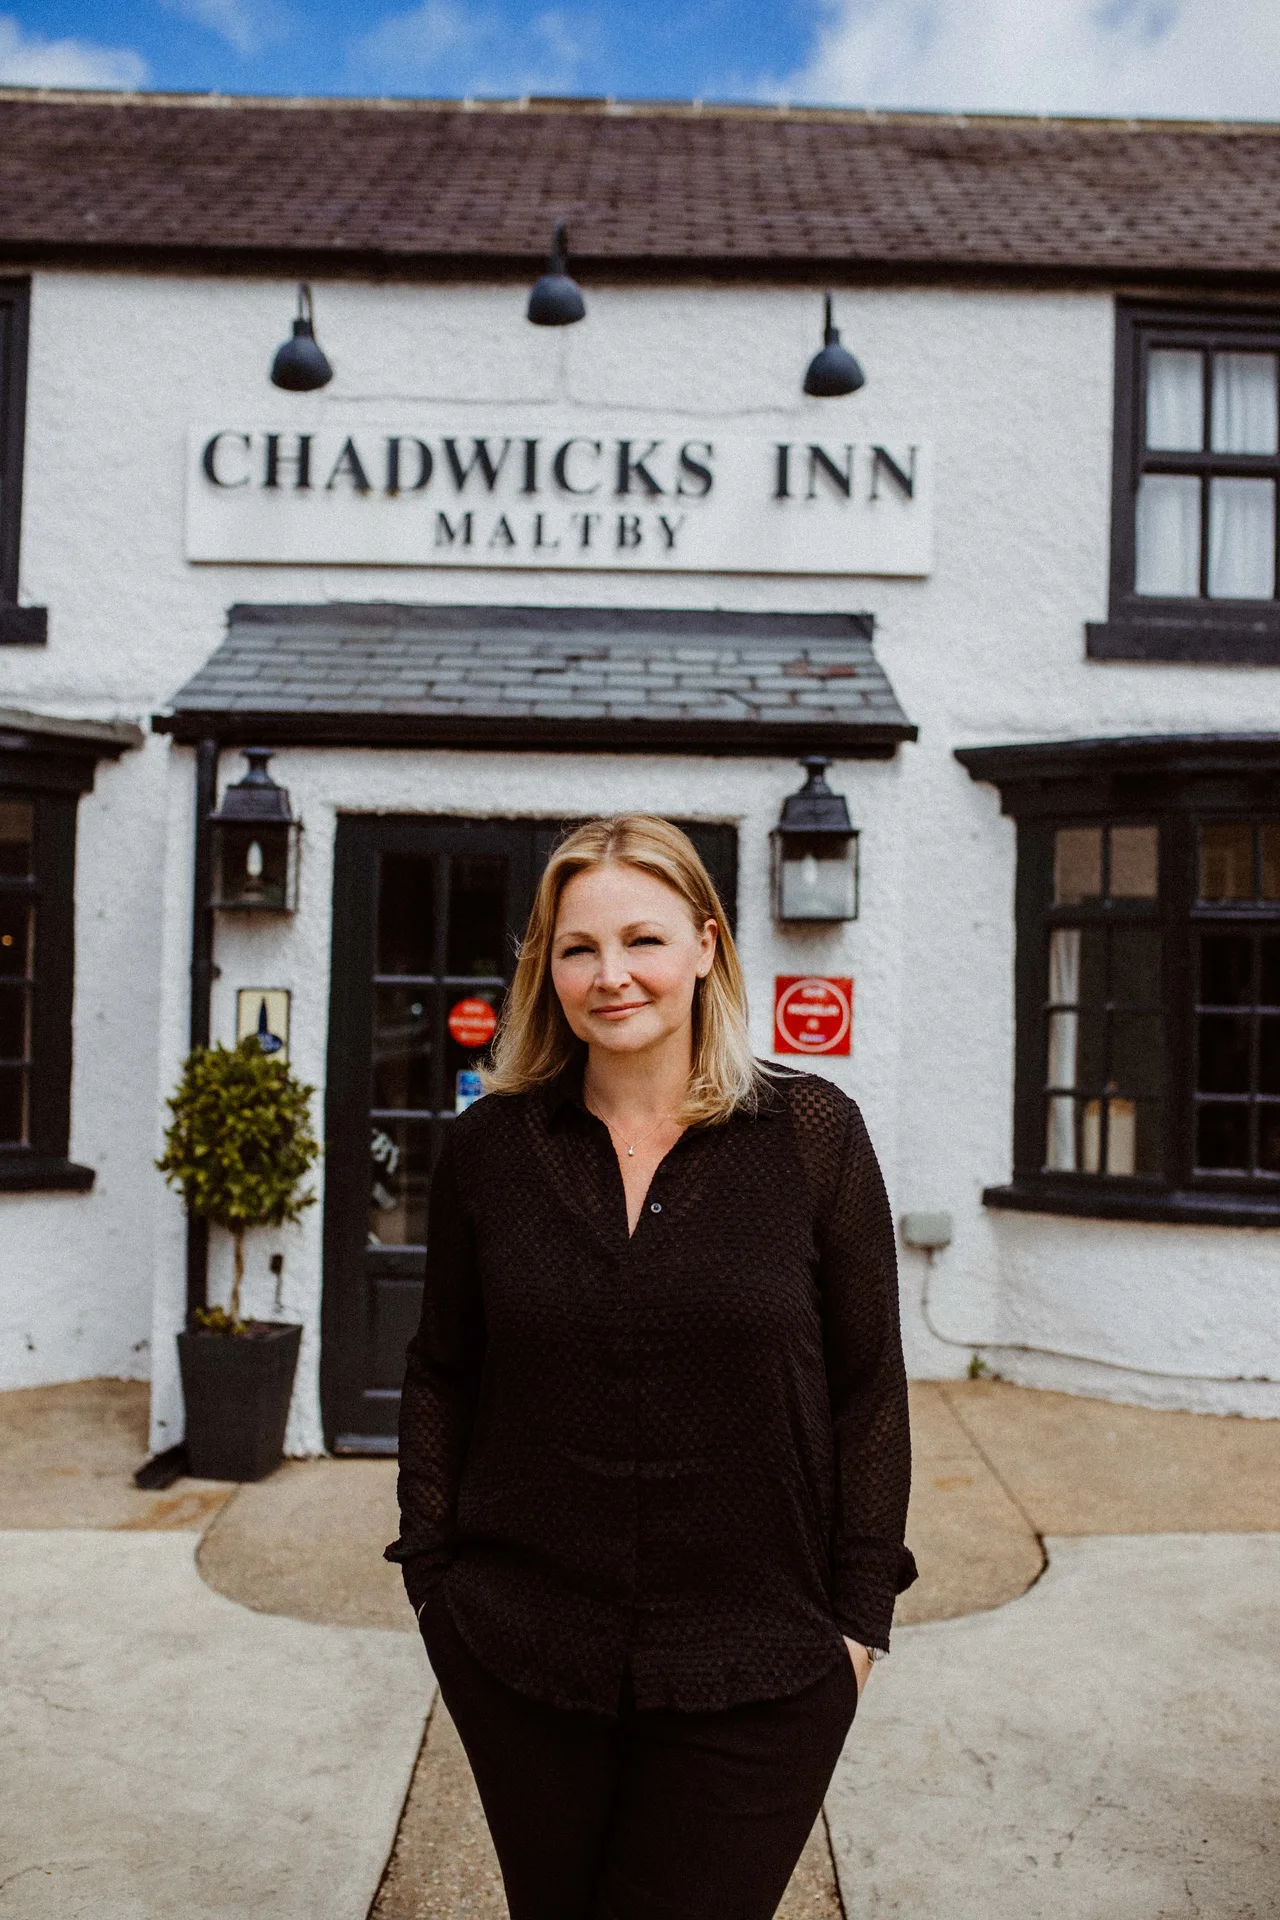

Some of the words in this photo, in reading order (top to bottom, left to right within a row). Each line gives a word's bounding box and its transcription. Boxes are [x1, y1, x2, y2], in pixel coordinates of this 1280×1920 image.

[202, 431, 716, 498] CHADWICKS
[773, 443, 919, 503] INN
[434, 510, 687, 551] MALTBY
